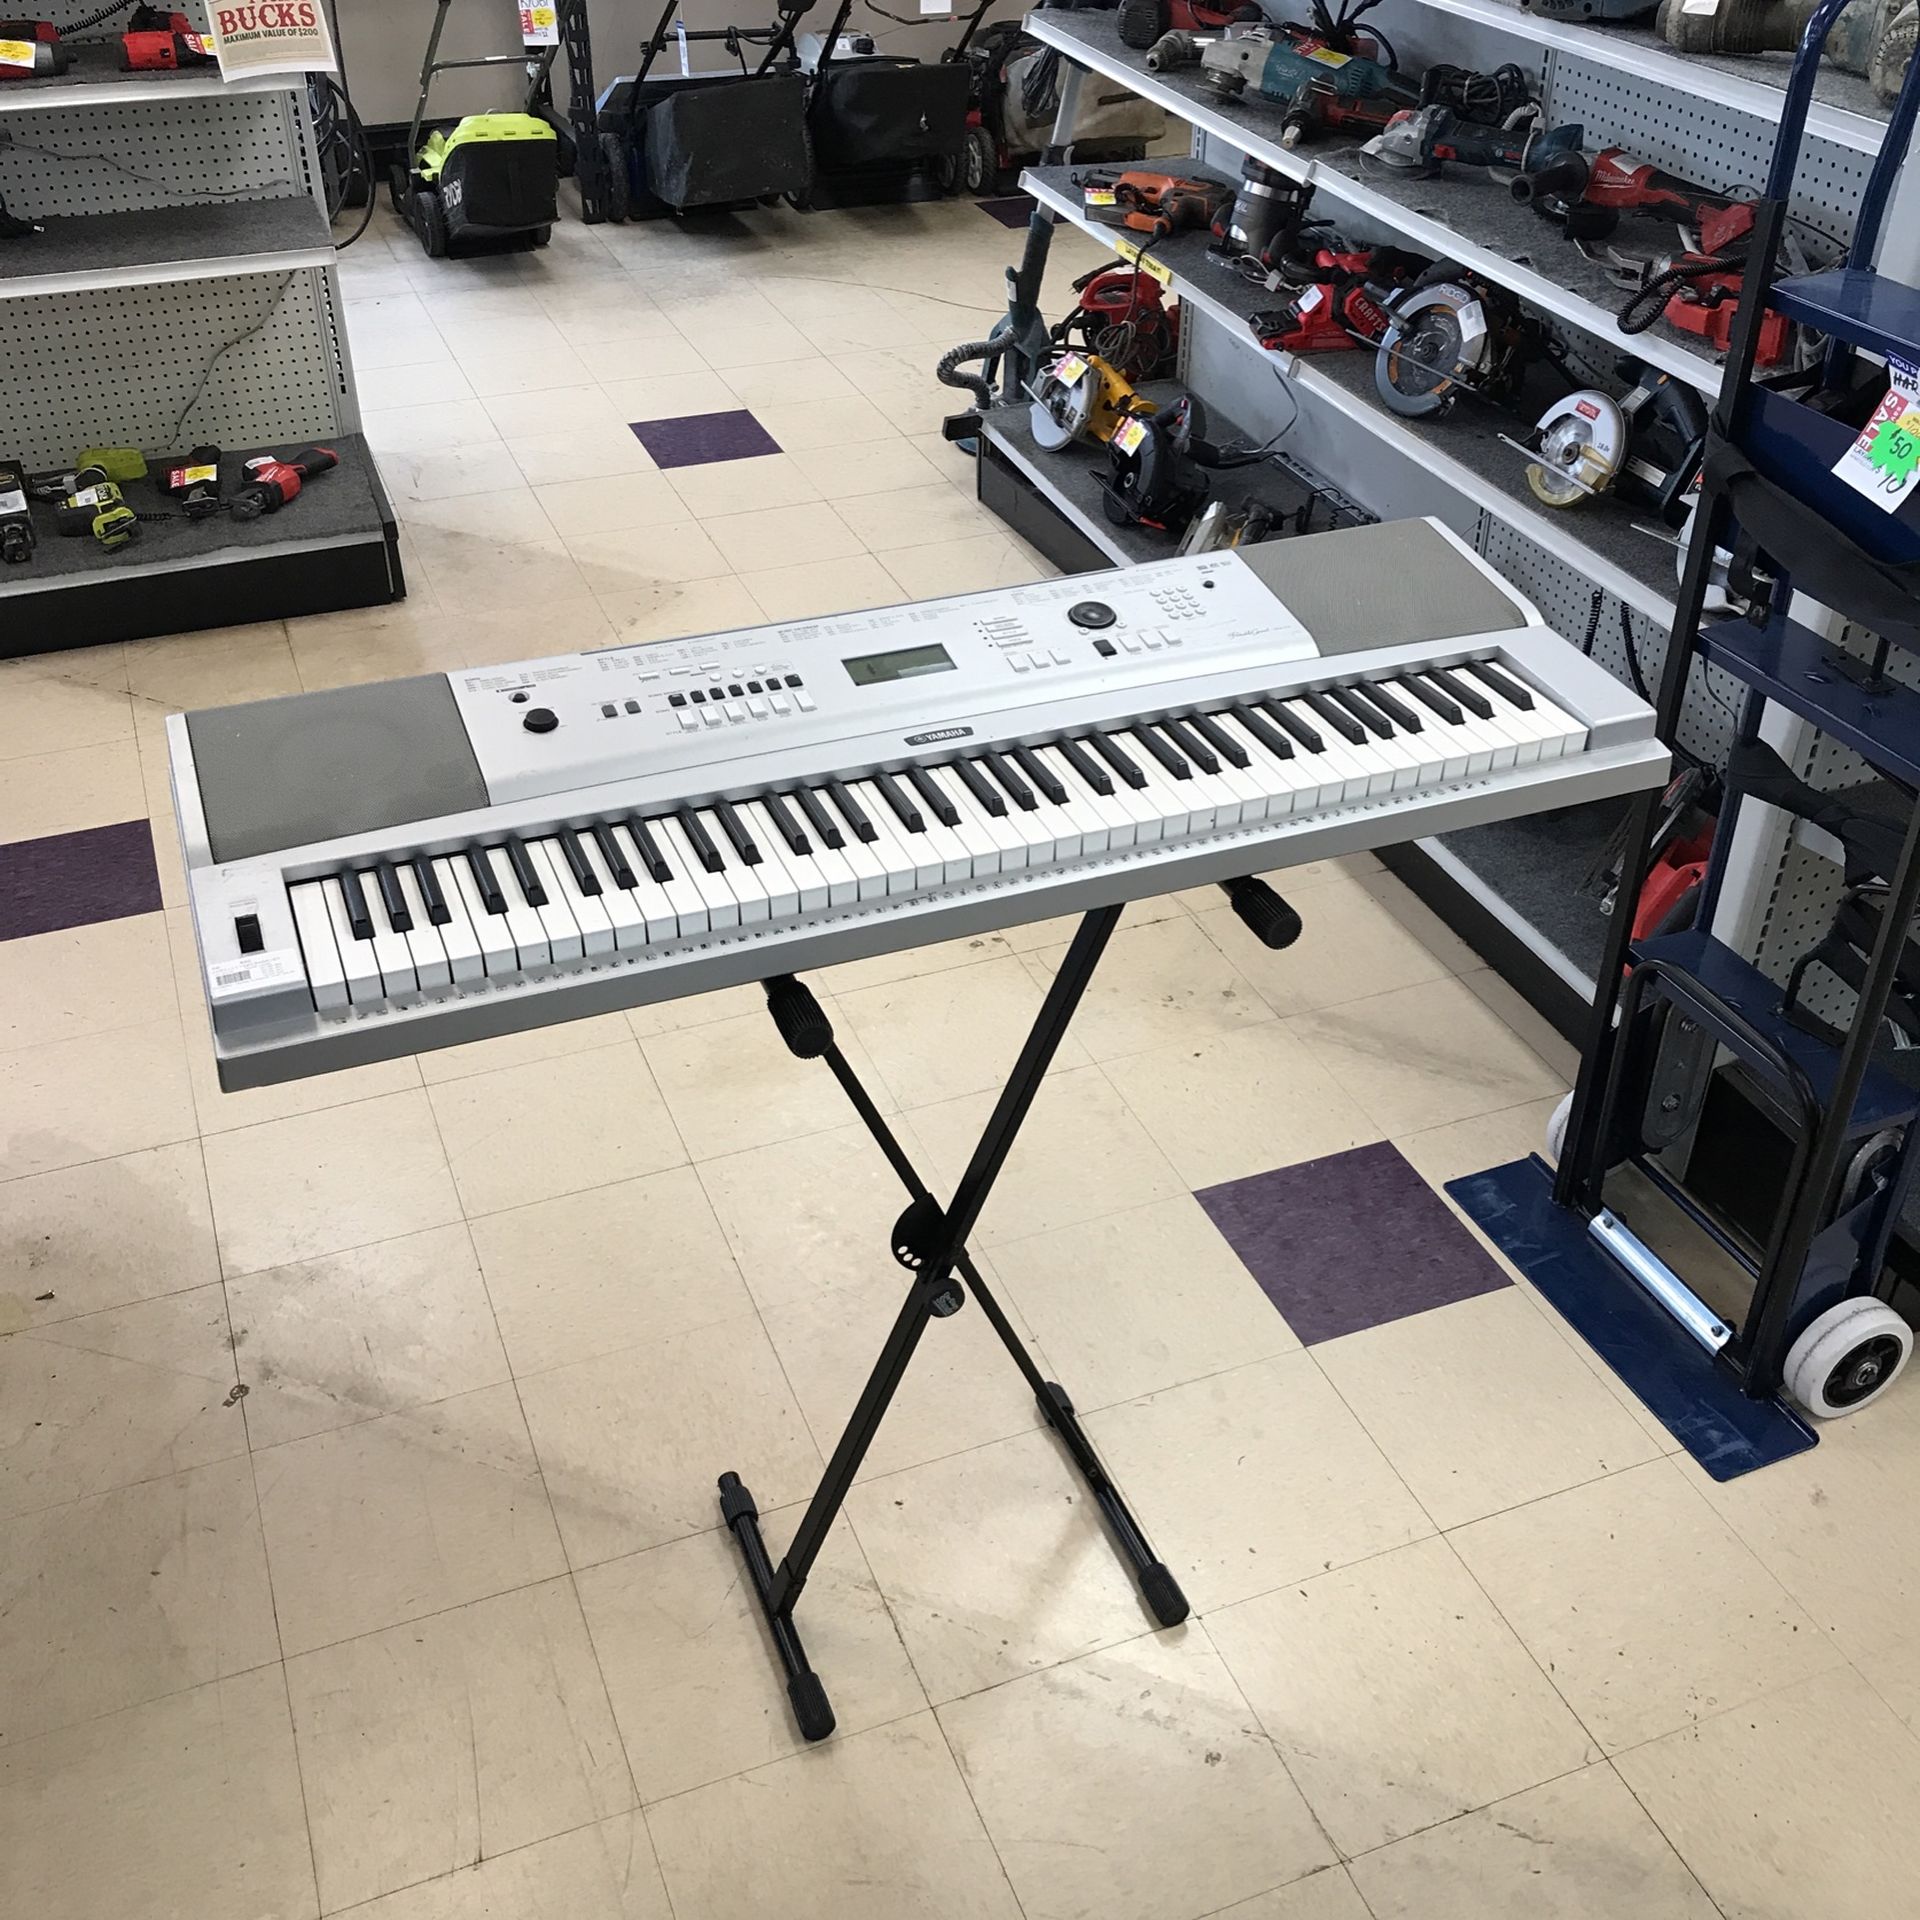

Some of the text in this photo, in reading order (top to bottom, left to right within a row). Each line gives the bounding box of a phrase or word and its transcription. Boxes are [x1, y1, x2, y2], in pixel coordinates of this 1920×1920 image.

[217, 2, 317, 36] BUCKS
[223, 30, 261, 45] MAXIMUM
[262, 28, 287, 38] VALUE
[287, 28, 298, 37] OF
[298, 27, 319, 38] $200
[1354, 297, 1388, 333] CRAFTS
[1888, 355, 1910, 372] YOU
[1857, 392, 1898, 452] SALE
[925, 728, 966, 741] YAMAHA
